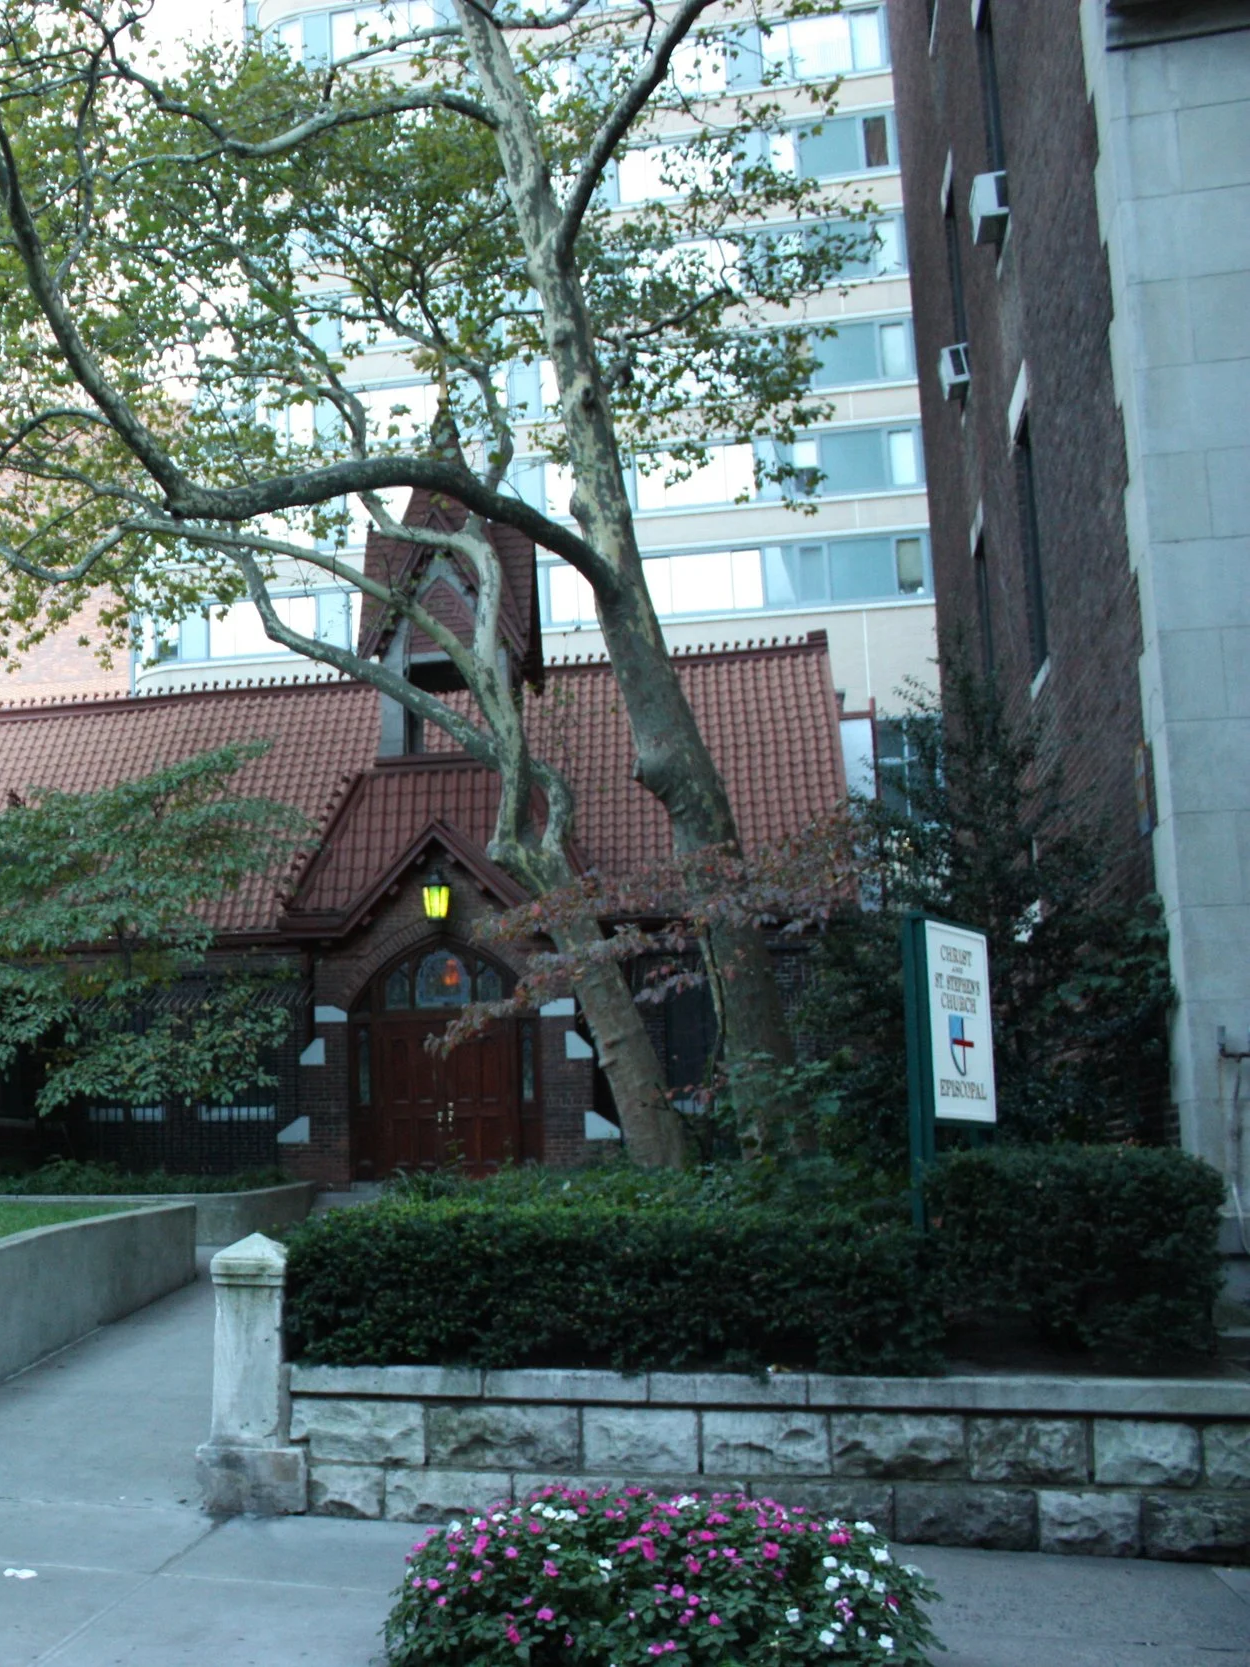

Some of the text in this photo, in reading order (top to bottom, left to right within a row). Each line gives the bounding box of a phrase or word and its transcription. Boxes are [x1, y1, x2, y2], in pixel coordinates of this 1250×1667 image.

[940, 944, 972, 968] CHRIST
[941, 991, 976, 1014] CHURCH
[940, 1079, 987, 1100] EPISCOPAL
